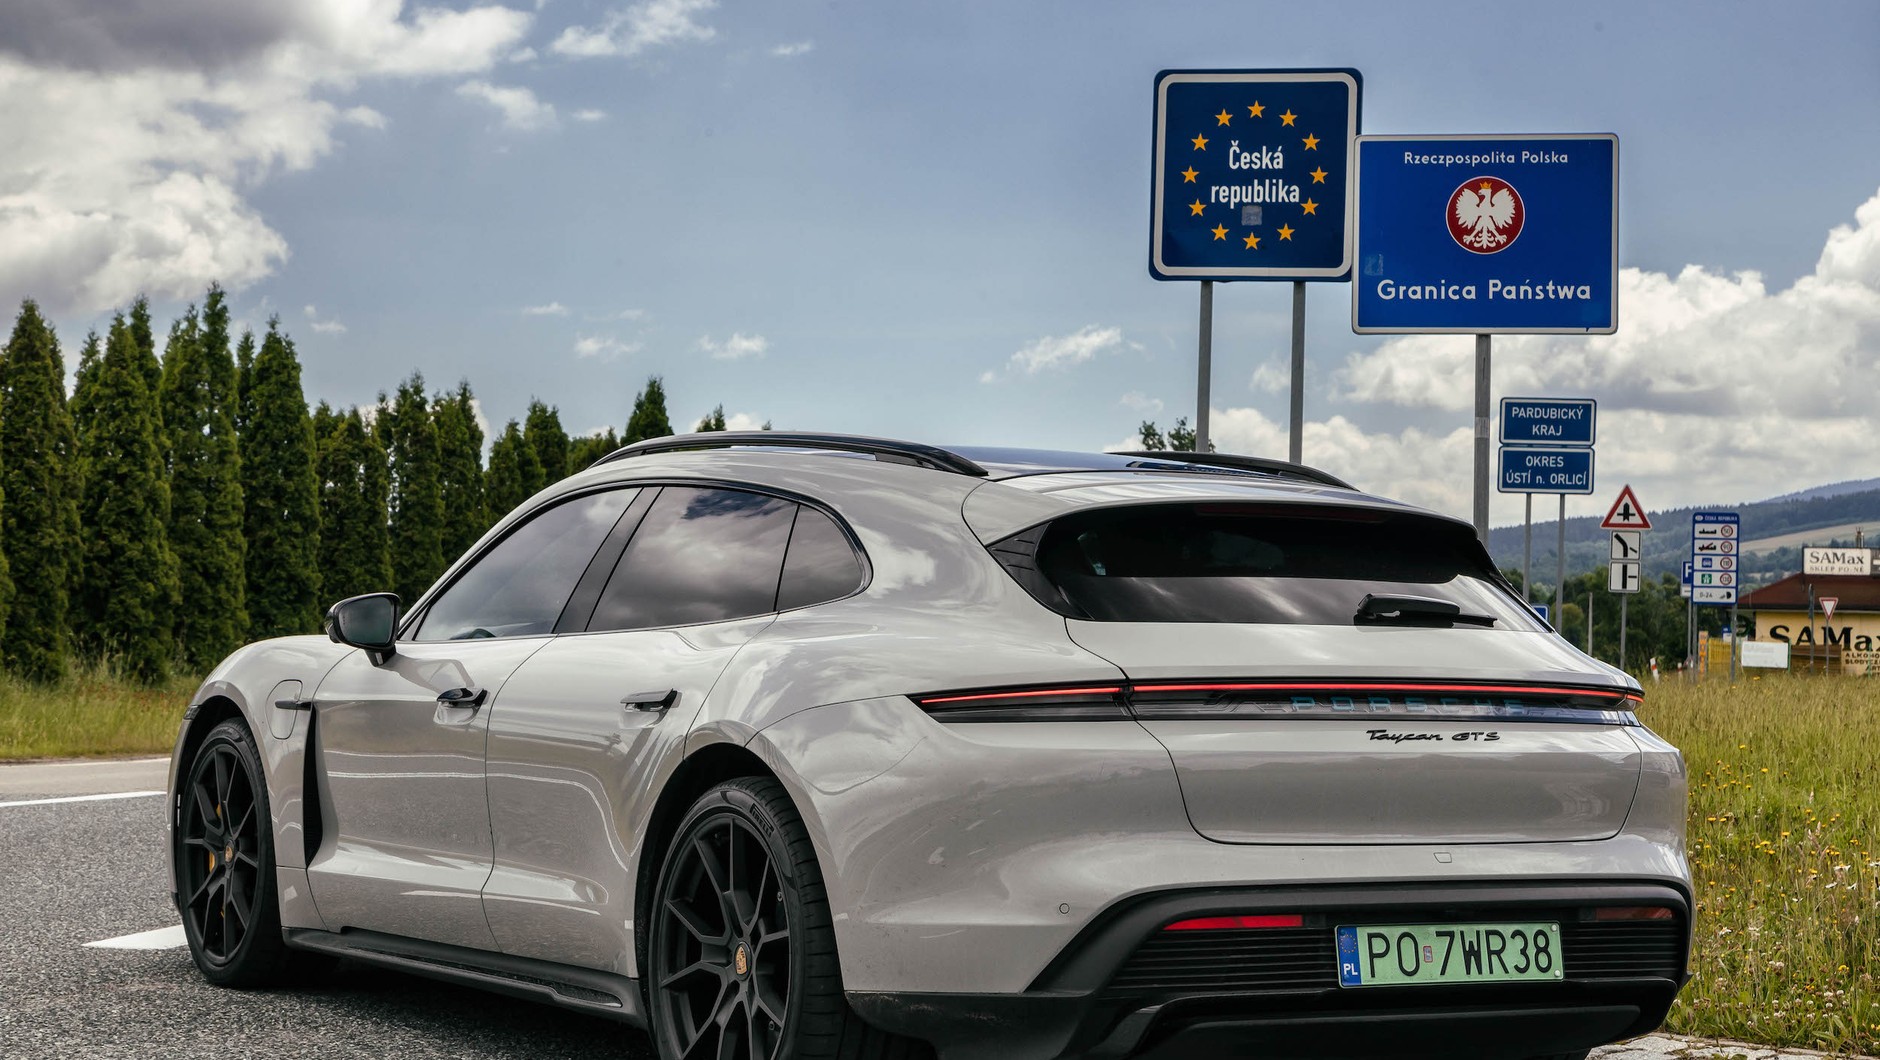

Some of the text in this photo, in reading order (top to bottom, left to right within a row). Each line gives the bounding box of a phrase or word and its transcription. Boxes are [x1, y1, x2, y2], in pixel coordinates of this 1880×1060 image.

[1228, 140, 1284, 170] Česká
[1404, 150, 1569, 168] Rzeczpospolita Polska
[1210, 179, 1300, 209] republika
[1377, 279, 1592, 300] Granica Państwa
[1512, 405, 1583, 419] PARDUBICKÝ
[1532, 424, 1562, 436] KRAJ
[1525, 455, 1564, 467] OKRES
[1506, 469, 1587, 485] ÚSTÍ n. ORLICÍ
[1809, 551, 1865, 564] SAMax
[1291, 697, 1525, 714] PORSCHE
[1366, 729, 1501, 745] Taycan GTS
[1367, 928, 1553, 978] PO 7WR38
[1343, 963, 1358, 976] PL
